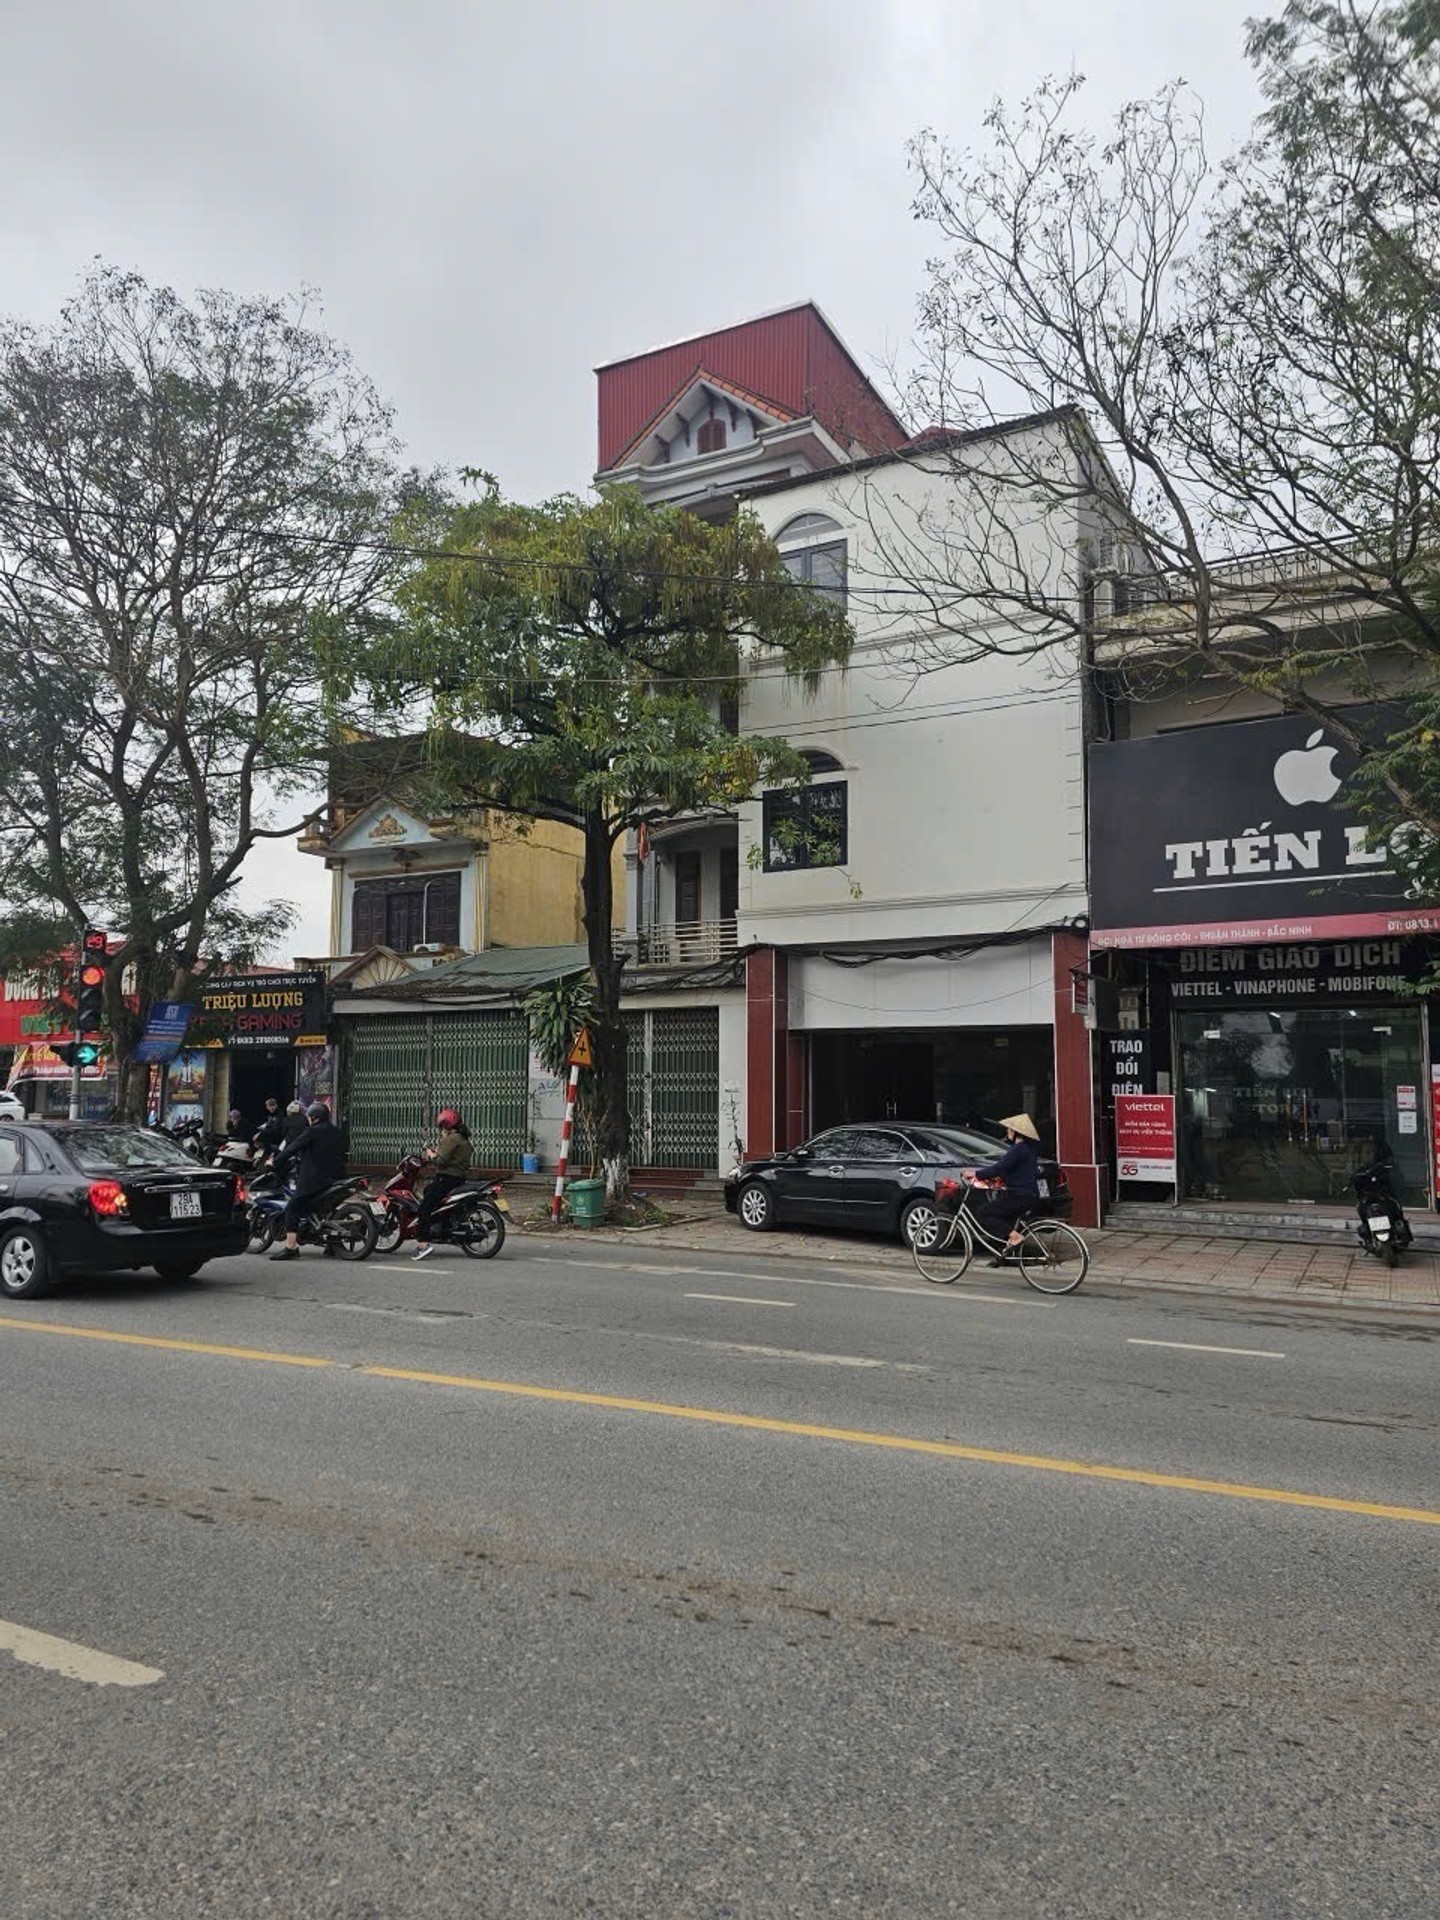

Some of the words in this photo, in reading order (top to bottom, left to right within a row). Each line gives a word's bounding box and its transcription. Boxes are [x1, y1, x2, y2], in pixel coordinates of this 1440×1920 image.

[1165, 821, 1321, 879] TIẾN
[1258, 946, 1320, 970] GIAO
[1335, 942, 1401, 970] DỊCH
[1171, 981, 1222, 997] VIETTEL
[1233, 978, 1316, 995] VINAPHONE
[1328, 975, 1406, 992] MOBIFONE
[202, 991, 248, 1012] TRIỆU
[237, 1012, 302, 1031] GAMING
[1110, 1040, 1143, 1054] TRAO
[1116, 1056, 1138, 1075] ĐỔI
[1125, 1102, 1165, 1112] viettel
[1121, 1164, 1138, 1176] 5G
